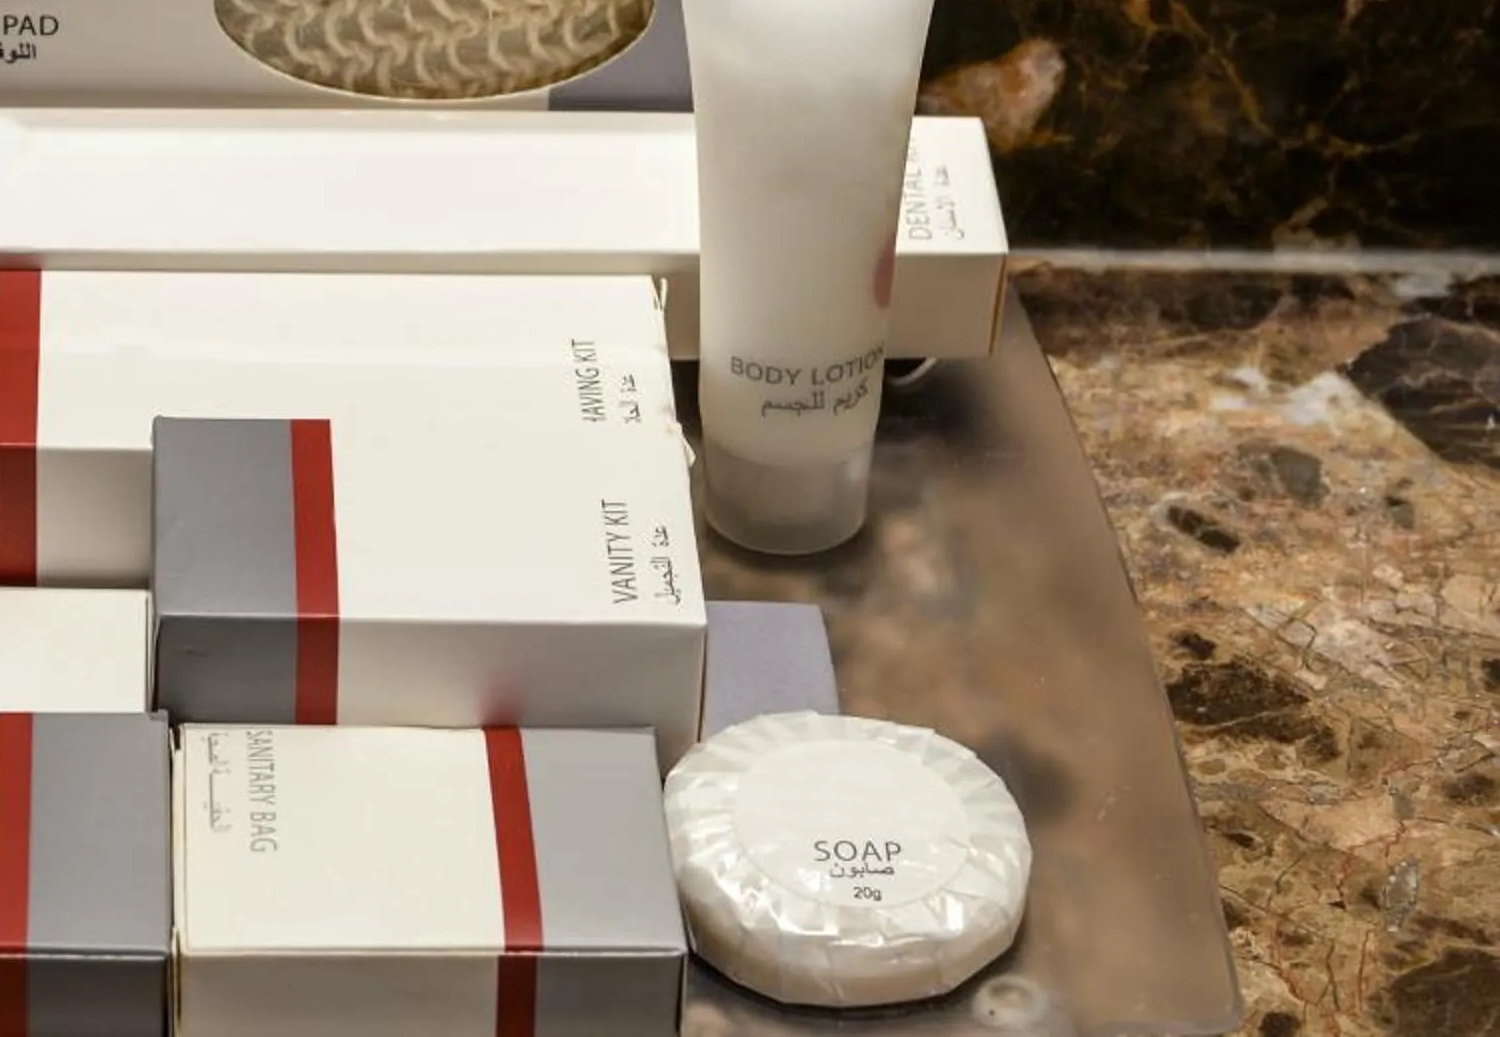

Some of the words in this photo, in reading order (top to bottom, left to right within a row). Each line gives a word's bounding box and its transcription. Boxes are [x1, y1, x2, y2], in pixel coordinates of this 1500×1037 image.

[3, 15, 59, 36] PAD
[905, 166, 933, 240] DENTAL
[571, 339, 597, 363] KIT
[730, 356, 802, 386] BODY
[575, 367, 606, 423] HAVING
[601, 499, 629, 526] KIT
[605, 532, 639, 604] VANITY
[246, 730, 277, 806] SANITARY
[249, 811, 278, 853] BAG
[813, 840, 902, 862] SOAP
[829, 862, 895, 878] صابون
[853, 886, 882, 901] 20g
